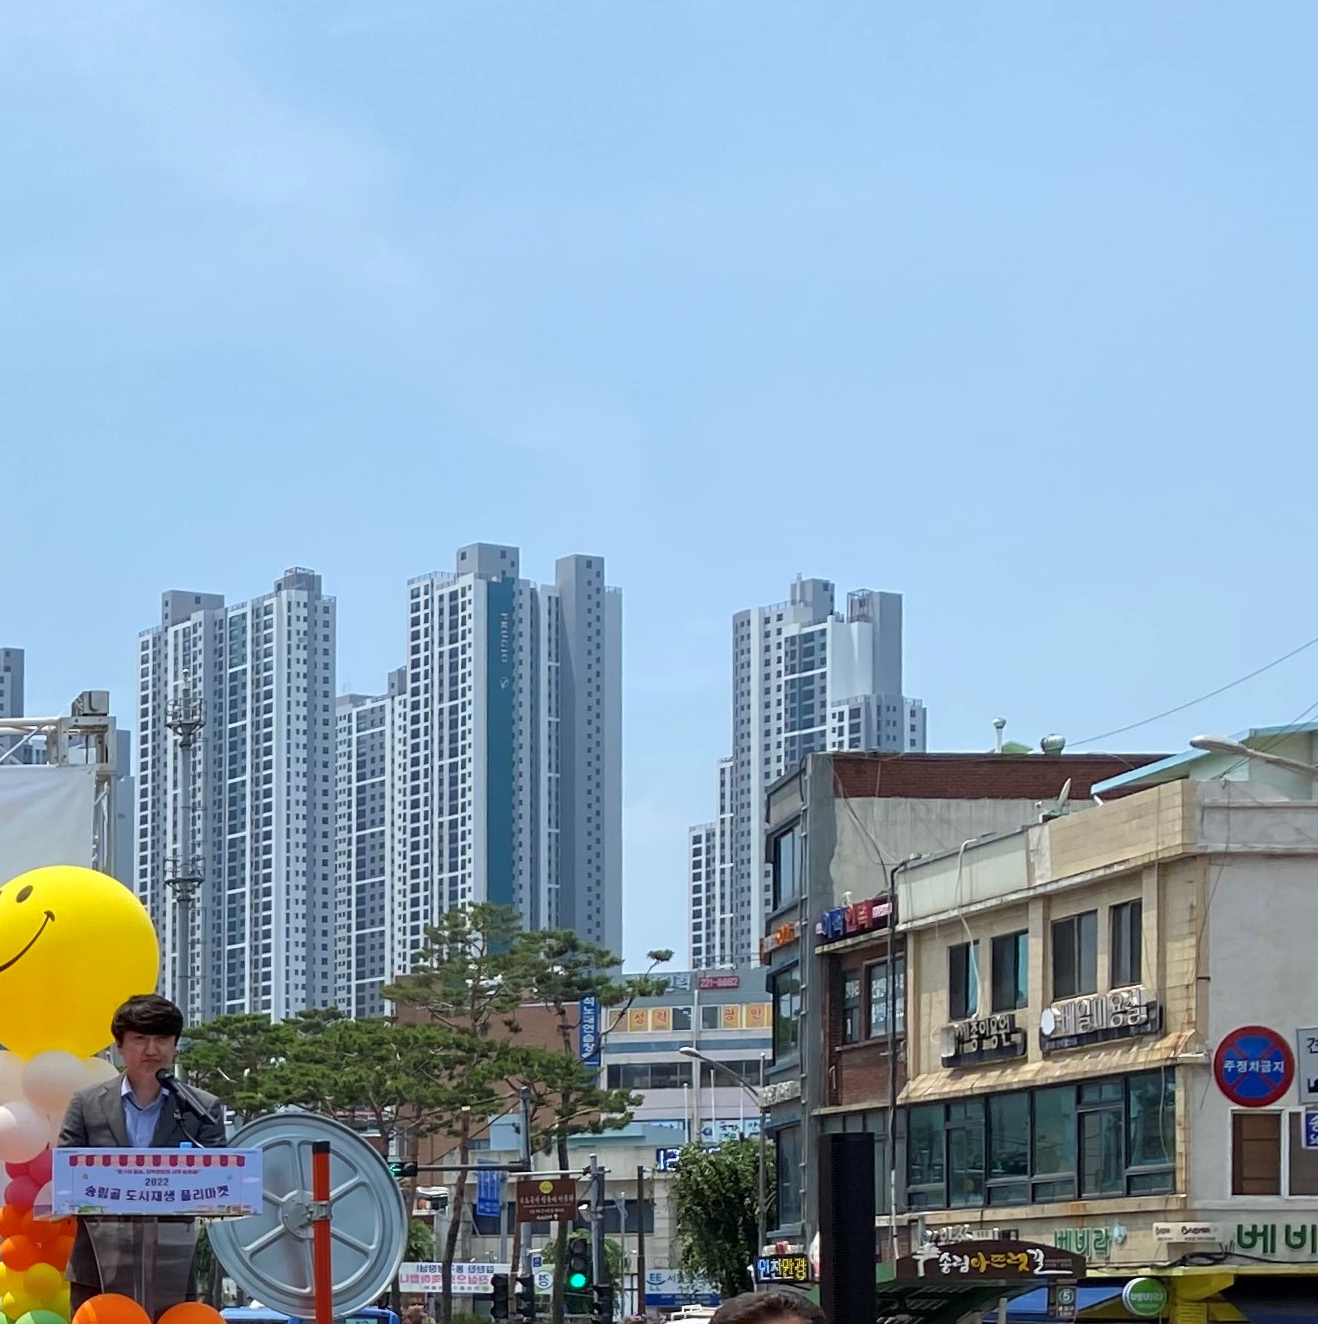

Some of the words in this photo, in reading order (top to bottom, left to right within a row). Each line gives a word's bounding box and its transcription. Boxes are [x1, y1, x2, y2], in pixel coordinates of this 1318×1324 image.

[1224, 1060, 1284, 1074] 주정차금지
[144, 1177, 170, 1187] 2022
[85, 1185, 121, 1201] 송림골
[126, 1189, 176, 1203] 도시재생
[181, 1184, 230, 1202] 플리마켓
